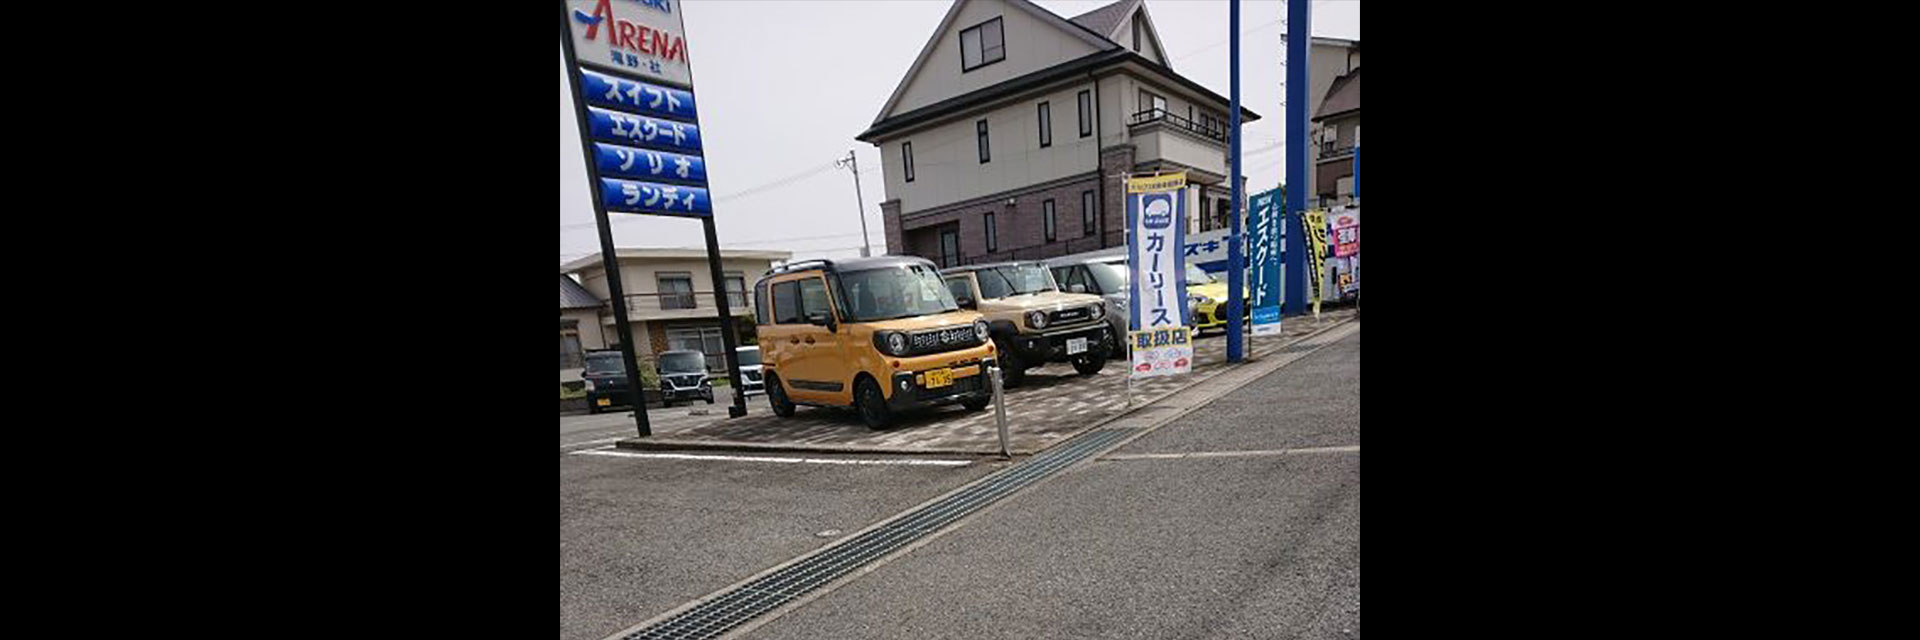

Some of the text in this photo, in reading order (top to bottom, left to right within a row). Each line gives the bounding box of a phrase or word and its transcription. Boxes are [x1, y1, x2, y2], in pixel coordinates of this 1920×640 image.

[576, 0, 685, 62] ARENA
[604, 79, 681, 112] スイフト
[609, 113, 686, 146] エスクード
[617, 149, 691, 177] ソリオ
[622, 183, 695, 210] ランディ
[1256, 206, 1270, 306] エスクード
[1147, 232, 1171, 326] カーリース
[1136, 329, 1188, 349] 取扱店
